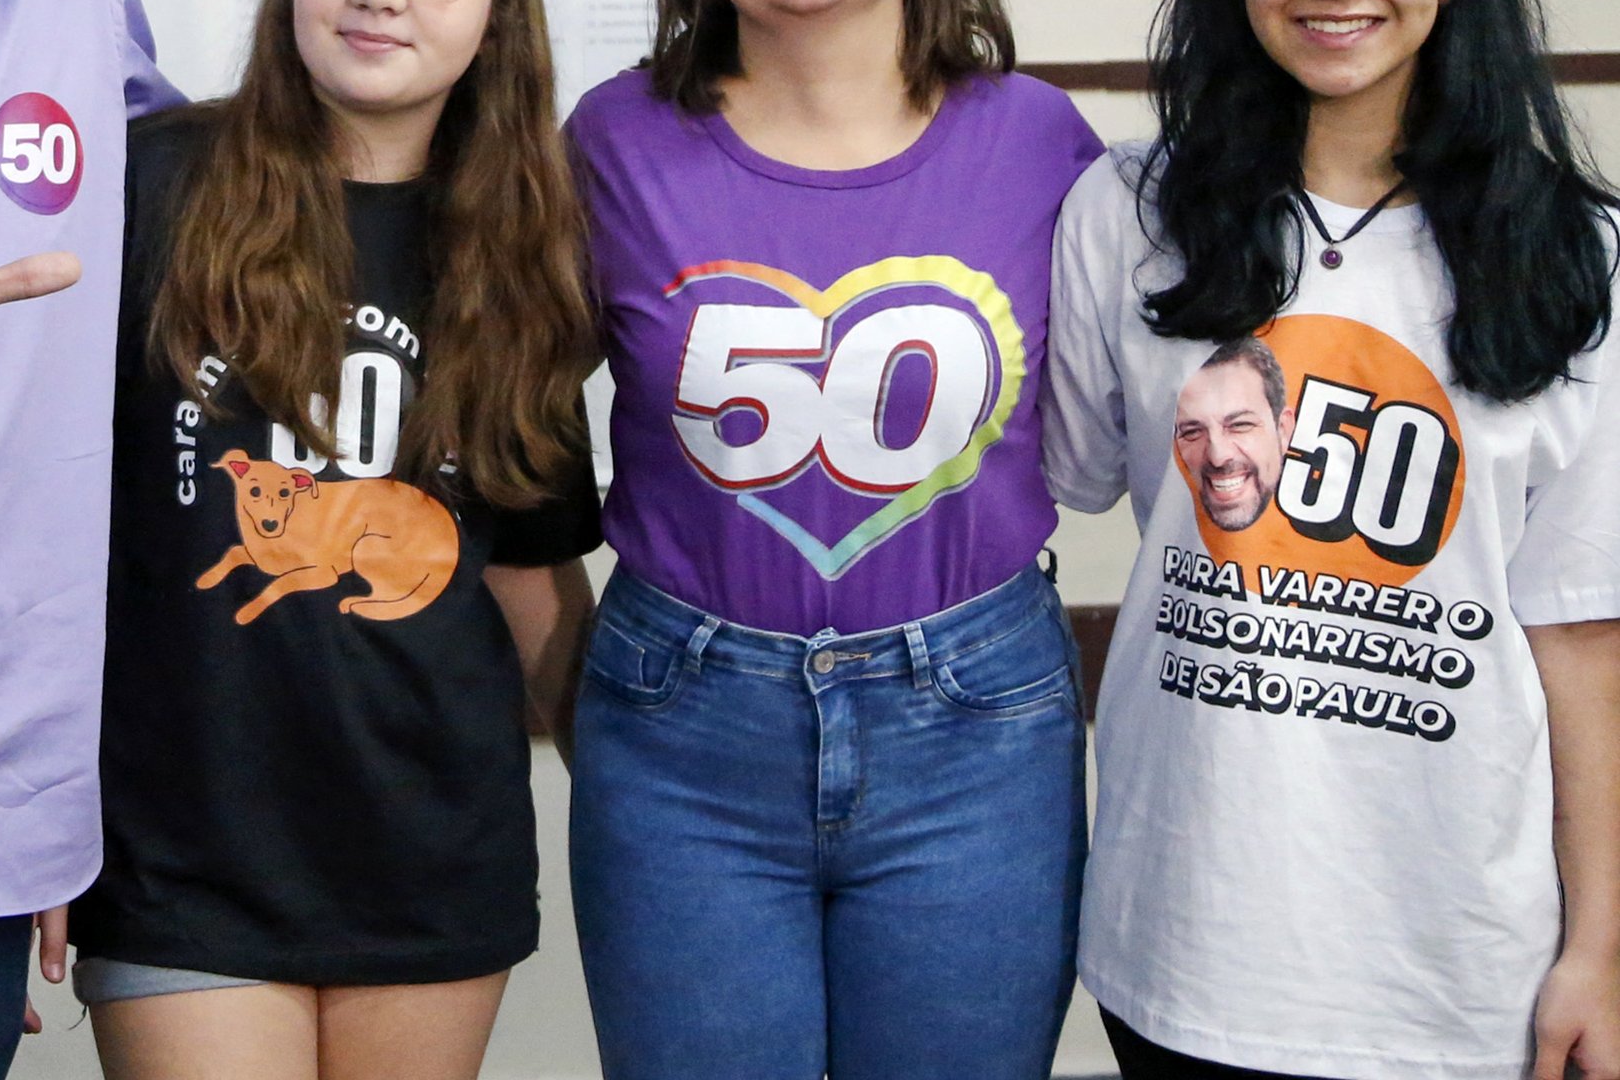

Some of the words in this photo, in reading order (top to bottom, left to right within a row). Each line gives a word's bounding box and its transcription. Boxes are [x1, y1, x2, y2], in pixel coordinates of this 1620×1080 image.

[0, 123, 77, 185] 50
[345, 304, 421, 360] om
[671, 303, 993, 499] 50
[1275, 373, 1460, 567] 50
[1164, 546, 1247, 602] PARA
[1257, 565, 1443, 634] VARRER
[1446, 600, 1494, 641] O
[1156, 593, 1475, 690] BOLSONARISMO
[1160, 651, 1199, 700] DE
[1196, 660, 1293, 715] SÃO
[1293, 677, 1457, 743] PAULO
